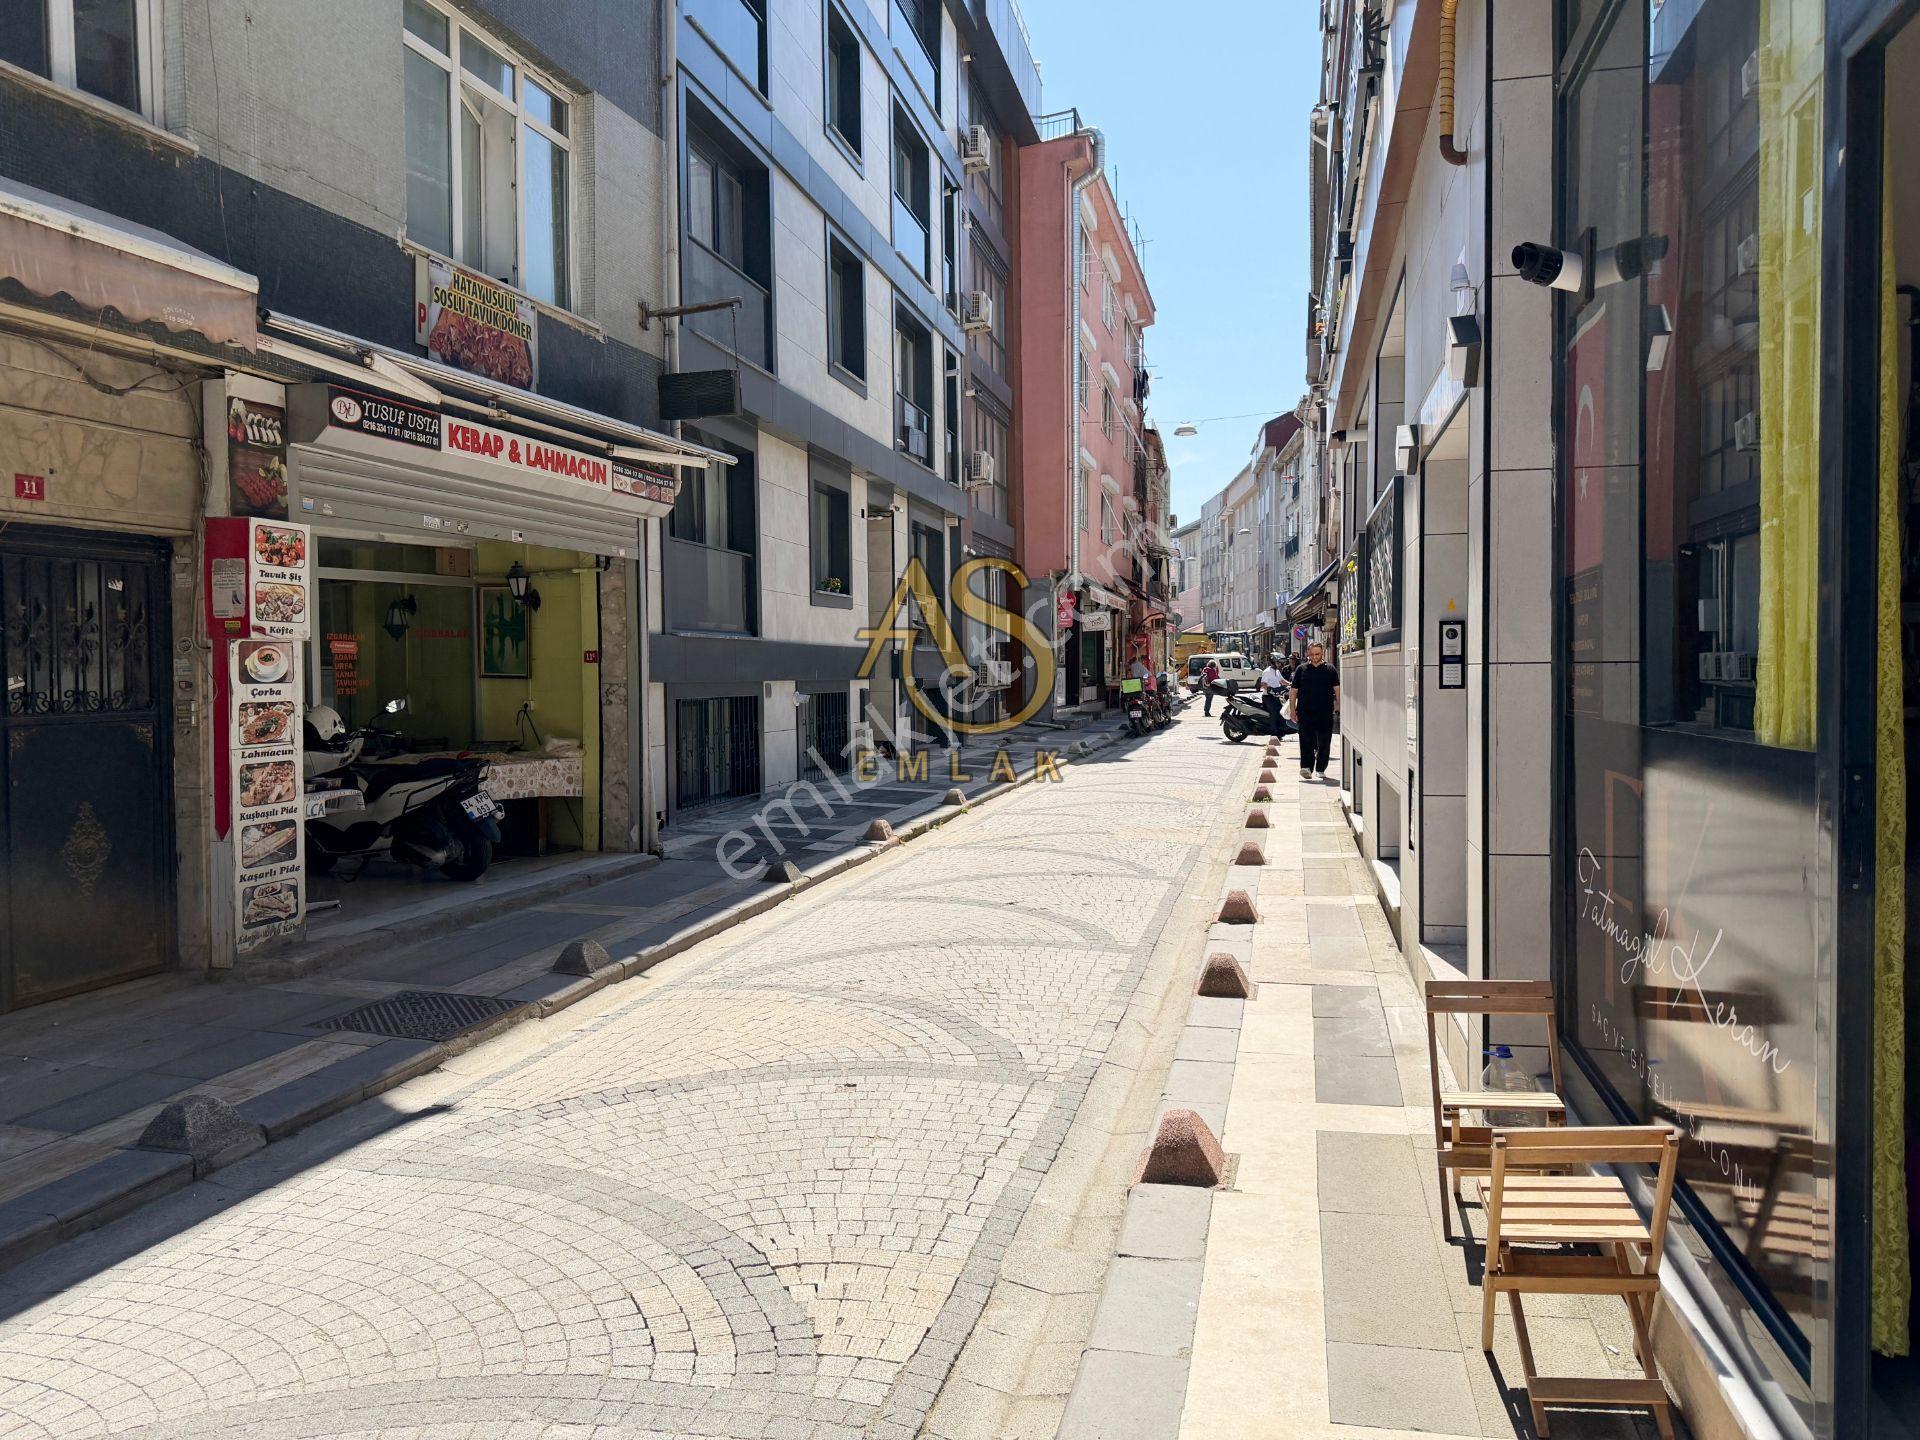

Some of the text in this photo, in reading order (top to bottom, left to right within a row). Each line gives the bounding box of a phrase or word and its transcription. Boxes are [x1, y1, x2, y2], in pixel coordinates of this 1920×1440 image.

[453, 272, 516, 314] HATAY USULÜ
[433, 286, 532, 340] SOSLU TAVUK DÖNER
[362, 419, 377, 431] 0216
[376, 423, 387, 433] 334
[387, 425, 393, 434] 17
[416, 432, 426, 443] 334
[426, 435, 432, 445] 27
[407, 412, 439, 434] USTA
[447, 422, 607, 485] KEBAP & LAHMACUN
[23, 481, 37, 494] 11
[259, 570, 302, 582] Tavuk Şiş
[269, 626, 294, 635] Köfte
[251, 688, 282, 698] Çorba
[241, 749, 294, 759] Lahmacun
[239, 806, 298, 822] Kuşbaşılı Pide
[463, 800, 474, 810] 34
[239, 865, 301, 884] Kaşarlı Pide
[1578, 847, 1792, 1074] Fatmagül Keran
[1591, 1002, 1610, 1043] SAÇ
[1612, 1026, 1626, 1057] VE
[1689, 1112, 1758, 1209] SALONU
